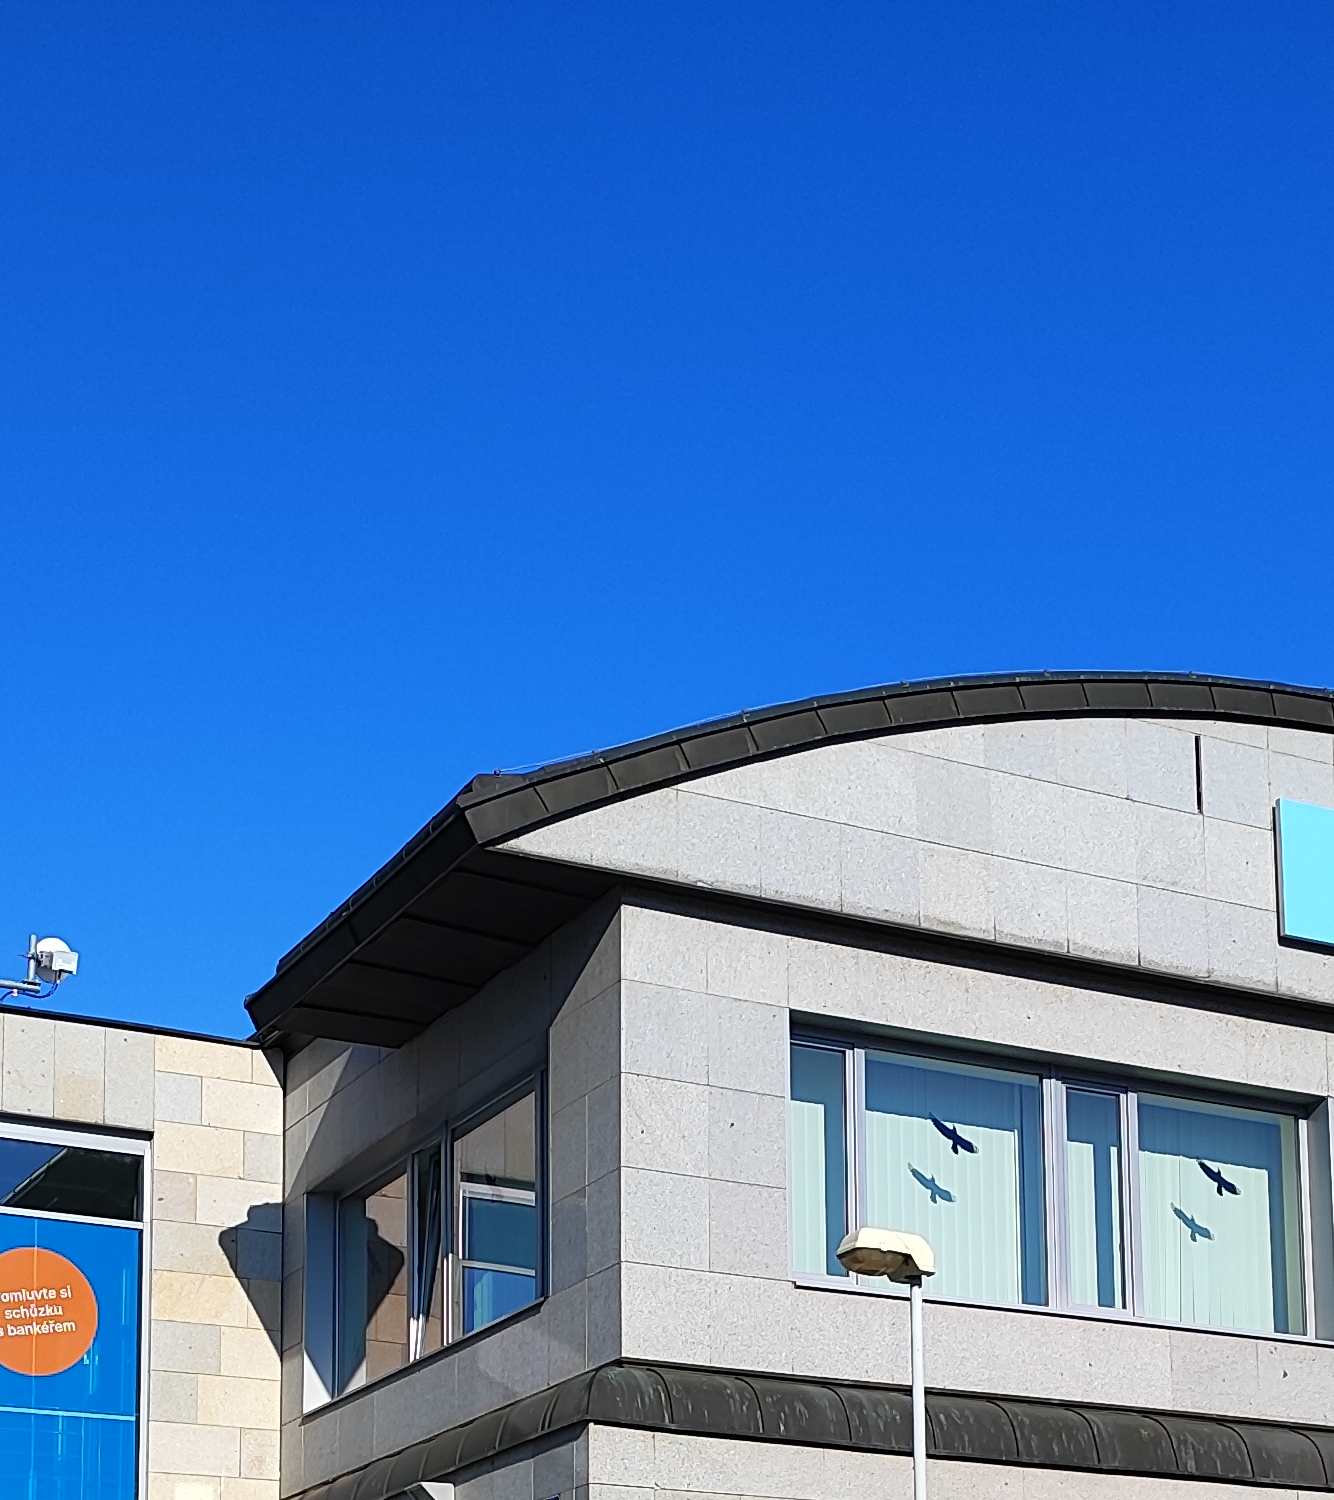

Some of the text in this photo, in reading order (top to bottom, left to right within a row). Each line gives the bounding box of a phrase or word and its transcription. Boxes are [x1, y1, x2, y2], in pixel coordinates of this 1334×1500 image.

[59, 1284, 72, 1299] si
[4, 1303, 64, 1320] schůzku
[6, 1319, 77, 1337] bankéřem
